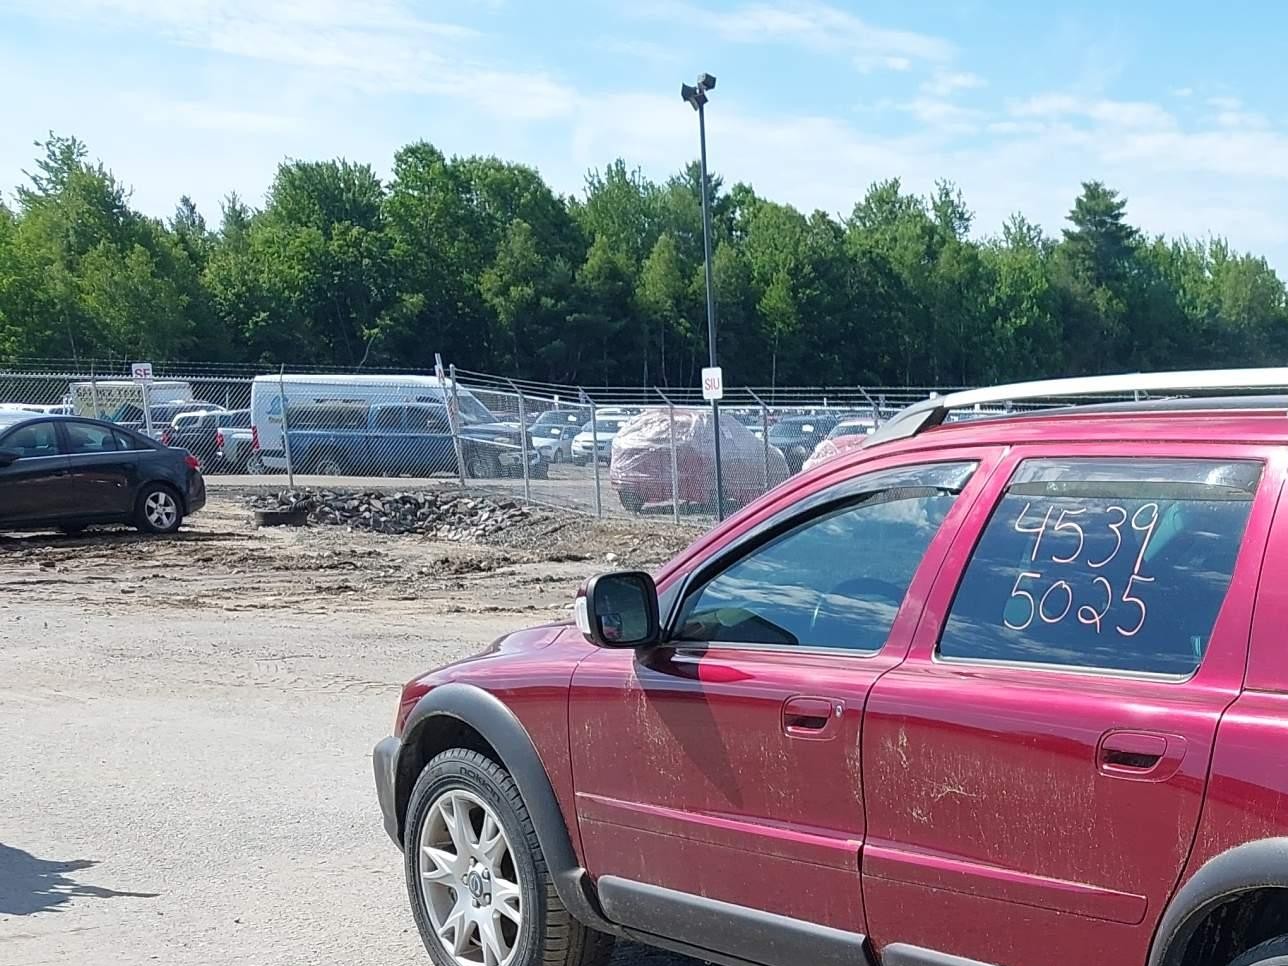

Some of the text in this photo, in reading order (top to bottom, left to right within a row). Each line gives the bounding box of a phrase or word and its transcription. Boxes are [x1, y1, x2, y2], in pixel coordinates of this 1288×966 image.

[704, 376, 720, 391] SIU
[1014, 501, 1159, 574] 4539
[1003, 572, 1155, 636] 5025
